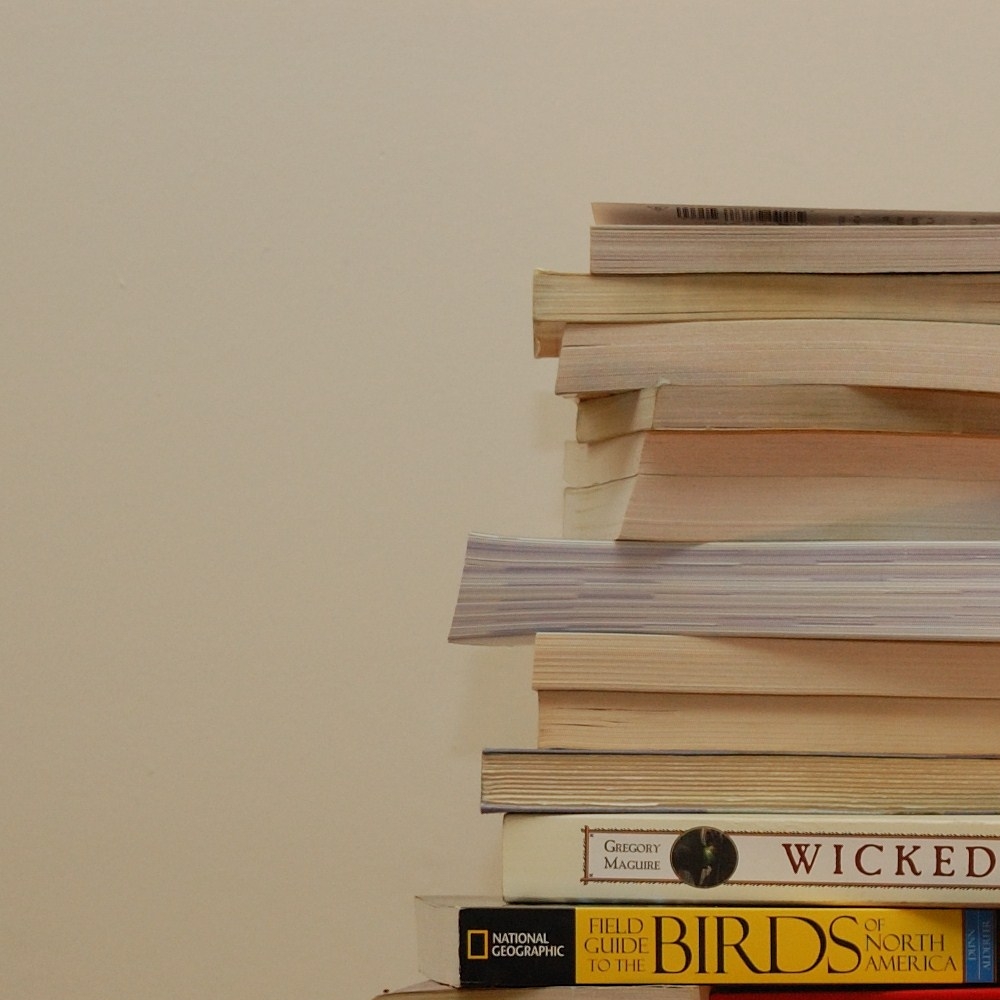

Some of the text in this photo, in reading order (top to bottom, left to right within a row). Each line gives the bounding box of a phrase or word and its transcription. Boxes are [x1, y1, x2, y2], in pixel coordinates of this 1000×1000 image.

[604, 840, 661, 854] GREGORY
[604, 857, 662, 871] MAGUIRE
[782, 843, 997, 878] WICKED
[589, 917, 644, 934] FIELD
[864, 918, 885, 931] OF
[491, 933, 550, 944] NATIONAL
[584, 937, 650, 954] GUIDE
[651, 914, 862, 975] BIRDS
[866, 933, 945, 951] NORTH
[491, 945, 565, 957] GEOGRAPHIC
[589, 959, 646, 972] TO THE
[865, 955, 957, 972] AMERICA
